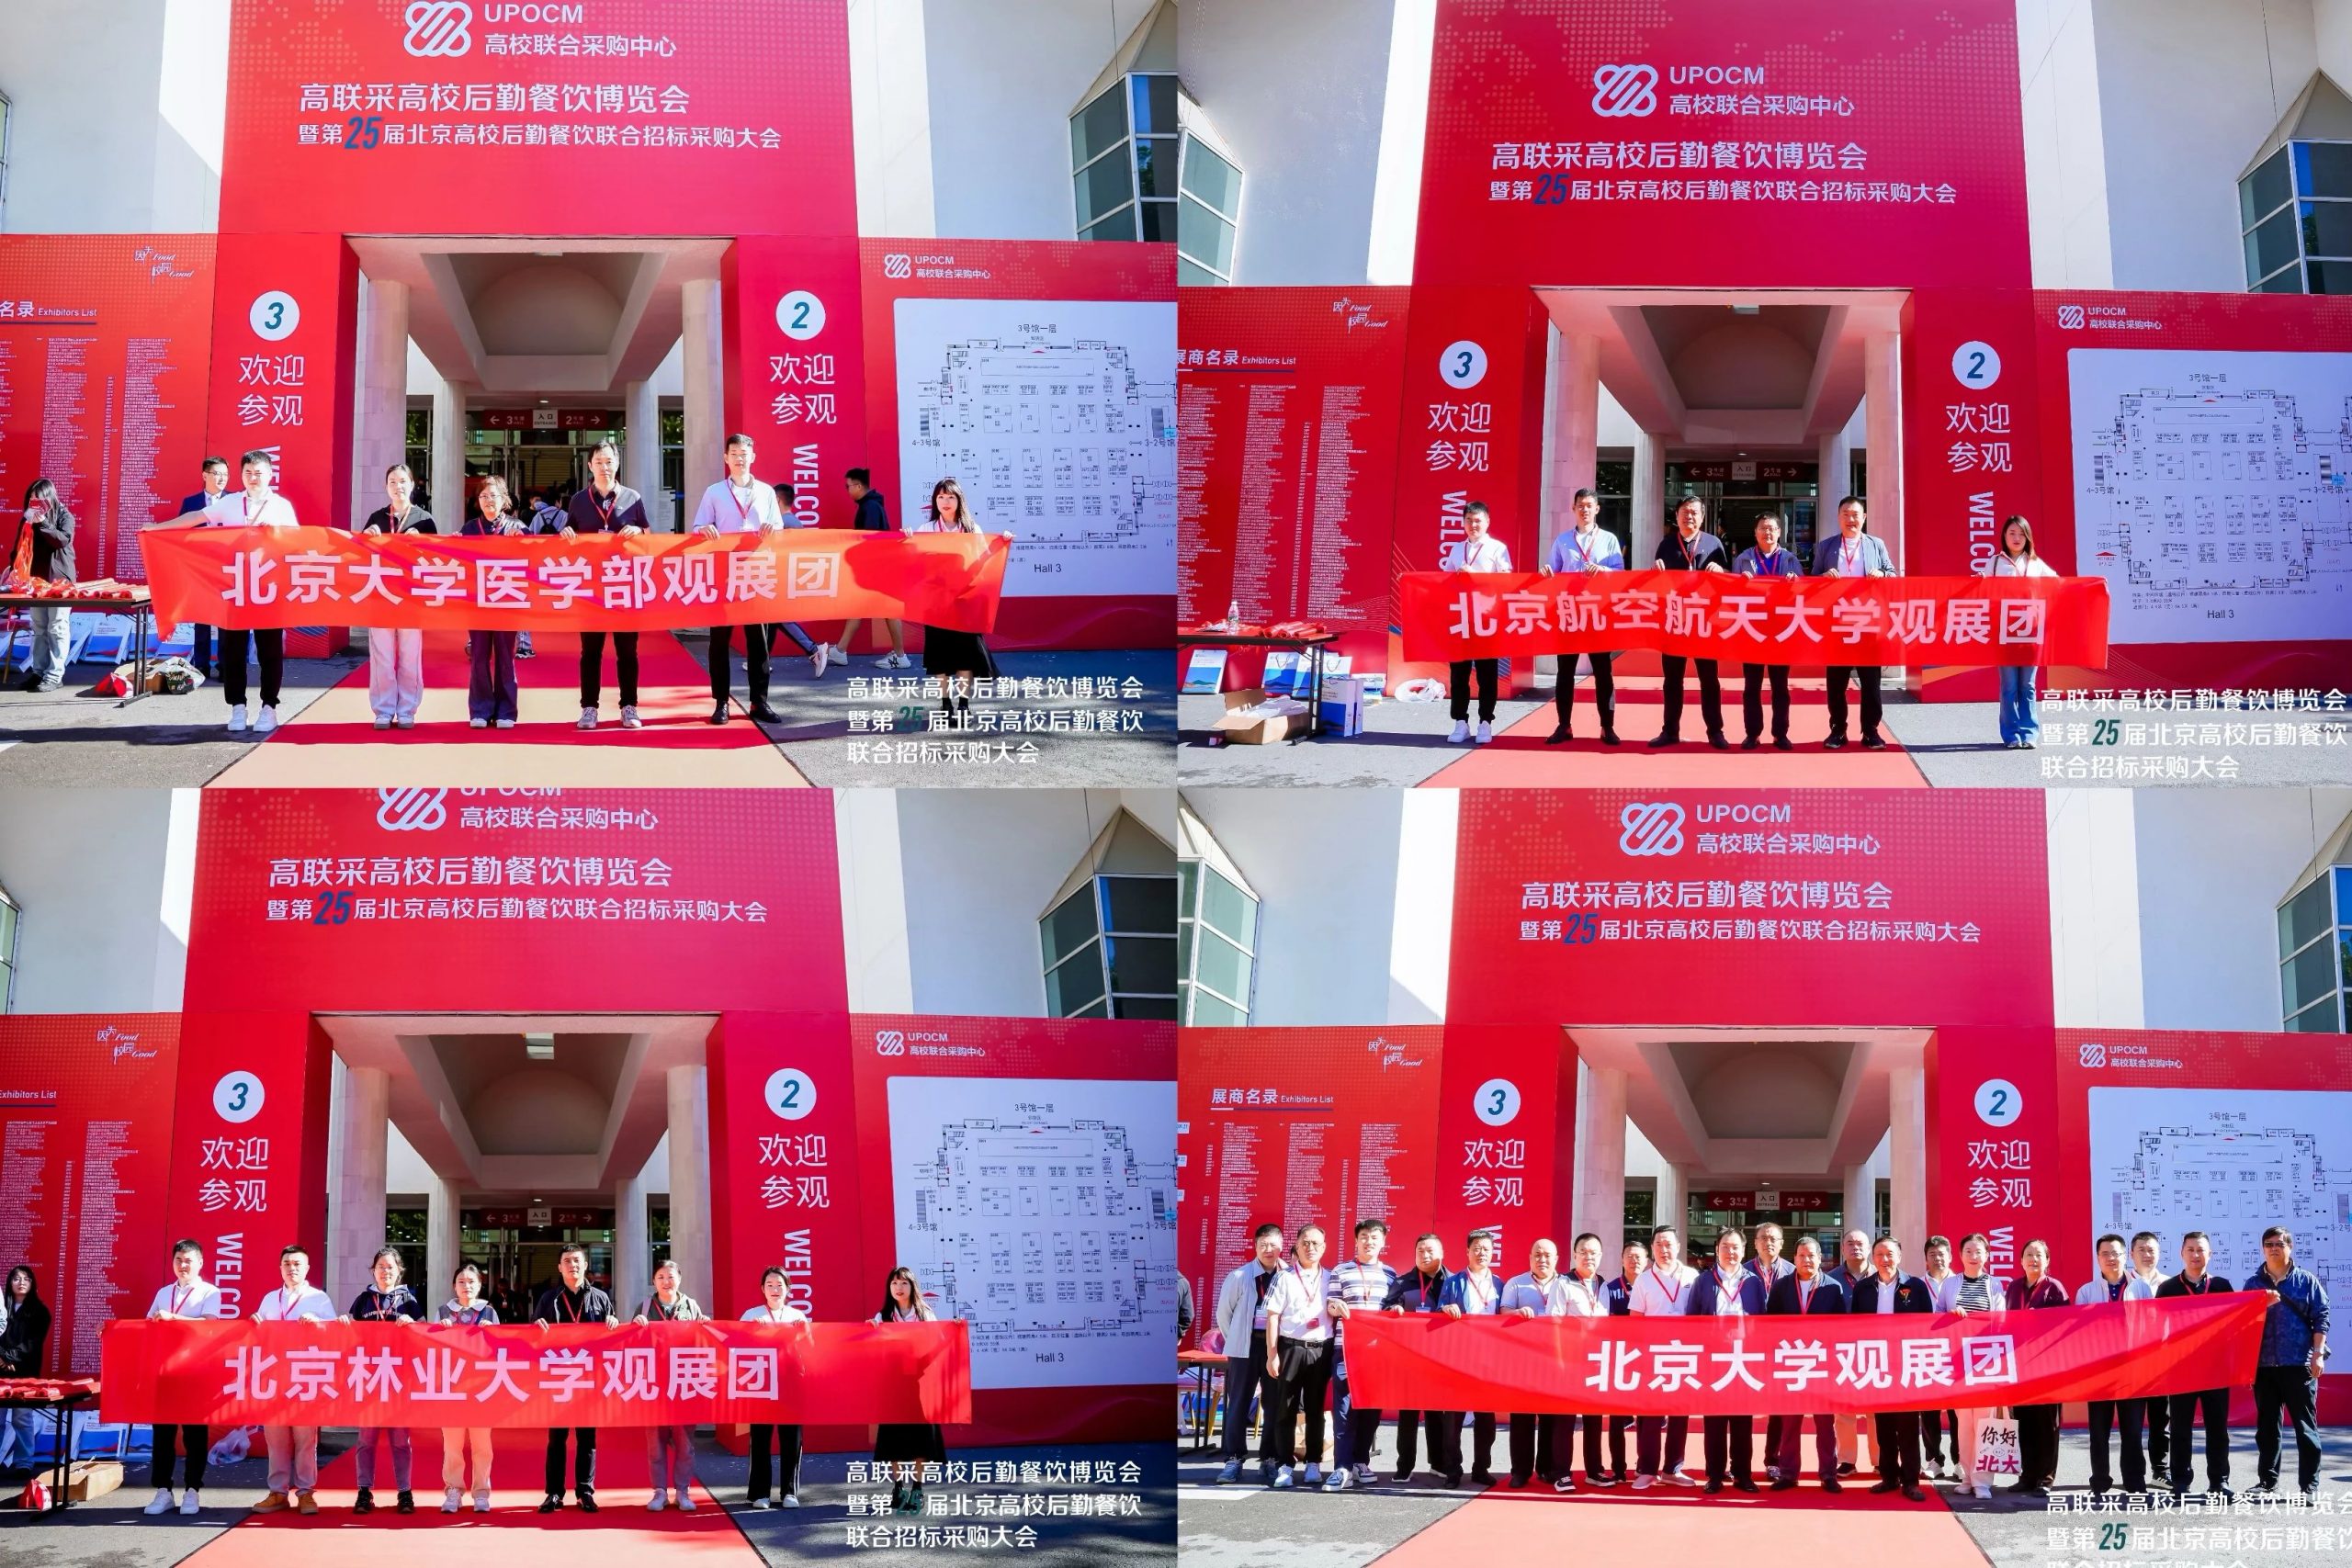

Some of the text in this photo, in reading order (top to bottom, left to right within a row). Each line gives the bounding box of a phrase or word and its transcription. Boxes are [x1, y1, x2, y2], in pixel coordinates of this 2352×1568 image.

[484, 4, 584, 23] UPOCM
[484, 34, 677, 58] 高校联合采购中心
[1669, 66, 1764, 85] UPOCM
[300, 83, 690, 114] 高联采高校后勤餐饮博览会
[1669, 95, 1855, 117] 高校联合采购中心
[298, 116, 782, 150] 暨第25届北京高校后勤餐饮联合招标采购大会
[1492, 141, 1867, 170] 高联采高校后勤餐饮博览会
[1488, 174, 1957, 205] 暨第25届北京高校后勤餐饮联合招标采购大会
[915, 255, 955, 265] UPOCM
[916, 268, 991, 279] 高校联合采购中心
[0, 301, 96, 318] 名录 Exhibitors List
[265, 302, 283, 330] 3
[790, 301, 810, 329] 2
[2087, 306, 2126, 315] UPOCM
[1017, 323, 1057, 333] 3号馆一层
[2089, 319, 2162, 331] 高校联合采购中心
[239, 354, 305, 386] 欢迎
[769, 353, 835, 385] 欢迎
[1242, 355, 1280, 365] Exhibitors
[1282, 355, 1296, 365] List
[1453, 351, 1473, 378] 3
[1967, 351, 1985, 379] 2
[237, 393, 303, 426] 参观
[771, 392, 837, 425] 参观
[1428, 402, 1491, 434] 欢迎
[1946, 402, 2011, 434] 欢迎
[911, 438, 941, 448] 4-3号馆
[1145, 438, 1175, 448] 3-2号馆
[1426, 440, 1489, 472] 参观
[1947, 442, 2012, 473] 参观
[2313, 486, 2344, 494] 3-2号馆
[221, 548, 840, 610] 北京大学医学部观展团
[1034, 563, 1062, 573] Hall 3
[1449, 588, 2046, 645] 北京航空航天大学观展团
[2207, 610, 2234, 618] Hall 3
[459, 806, 659, 830] 高校联合采购中心
[1696, 805, 1791, 823] UPOCM
[1696, 832, 1881, 855] 高校联合采购中心
[268, 856, 673, 888] 高联采高校后勤餐饮博览会
[266, 891, 768, 924] 暨第25届北京高校后勤餐饮联合招标采购大会
[1521, 880, 1892, 909] 高联采高校后勤餐饮博览会
[1519, 913, 1981, 943] 暨第25届北京高校后勤餐饮联合招标采购大会
[908, 1032, 948, 1042] UPOCM
[2109, 1045, 2147, 1055] UPOCM
[910, 1045, 986, 1057] 高校联合采购中心
[2110, 1058, 2183, 1069] 高校联合采购中心
[40, 1090, 57, 1099] List
[228, 1082, 248, 1111] 3
[780, 1079, 800, 1110] 2
[1014, 1103, 1054, 1113] 3号馆一层
[1211, 1089, 1334, 1104] 展商名录 Exhibitors List
[1487, 1089, 1506, 1116] 3
[1988, 1089, 2007, 1116] 2
[2209, 1112, 2247, 1122] 3号馆一层
[200, 1136, 269, 1171] 欢迎
[758, 1133, 828, 1167] 欢迎
[1463, 1138, 1525, 1169] 欢迎
[1967, 1139, 2030, 1169] 欢迎
[198, 1179, 267, 1213] 参观
[761, 1175, 830, 1209] 参观
[1462, 1175, 1523, 1207] 参观
[1969, 1177, 2032, 1208] 参观
[908, 1223, 938, 1232] 4-3号馆
[2105, 1223, 2132, 1231] 4-3号馆
[1036, 1353, 1064, 1362] Hall 3
[1585, 1335, 2018, 1393] 北京大学观展团
[223, 1346, 780, 1403] 北京林业大学观展团
[1981, 1426, 2017, 1447] 你好
[1976, 1454, 2019, 1474] 北大
